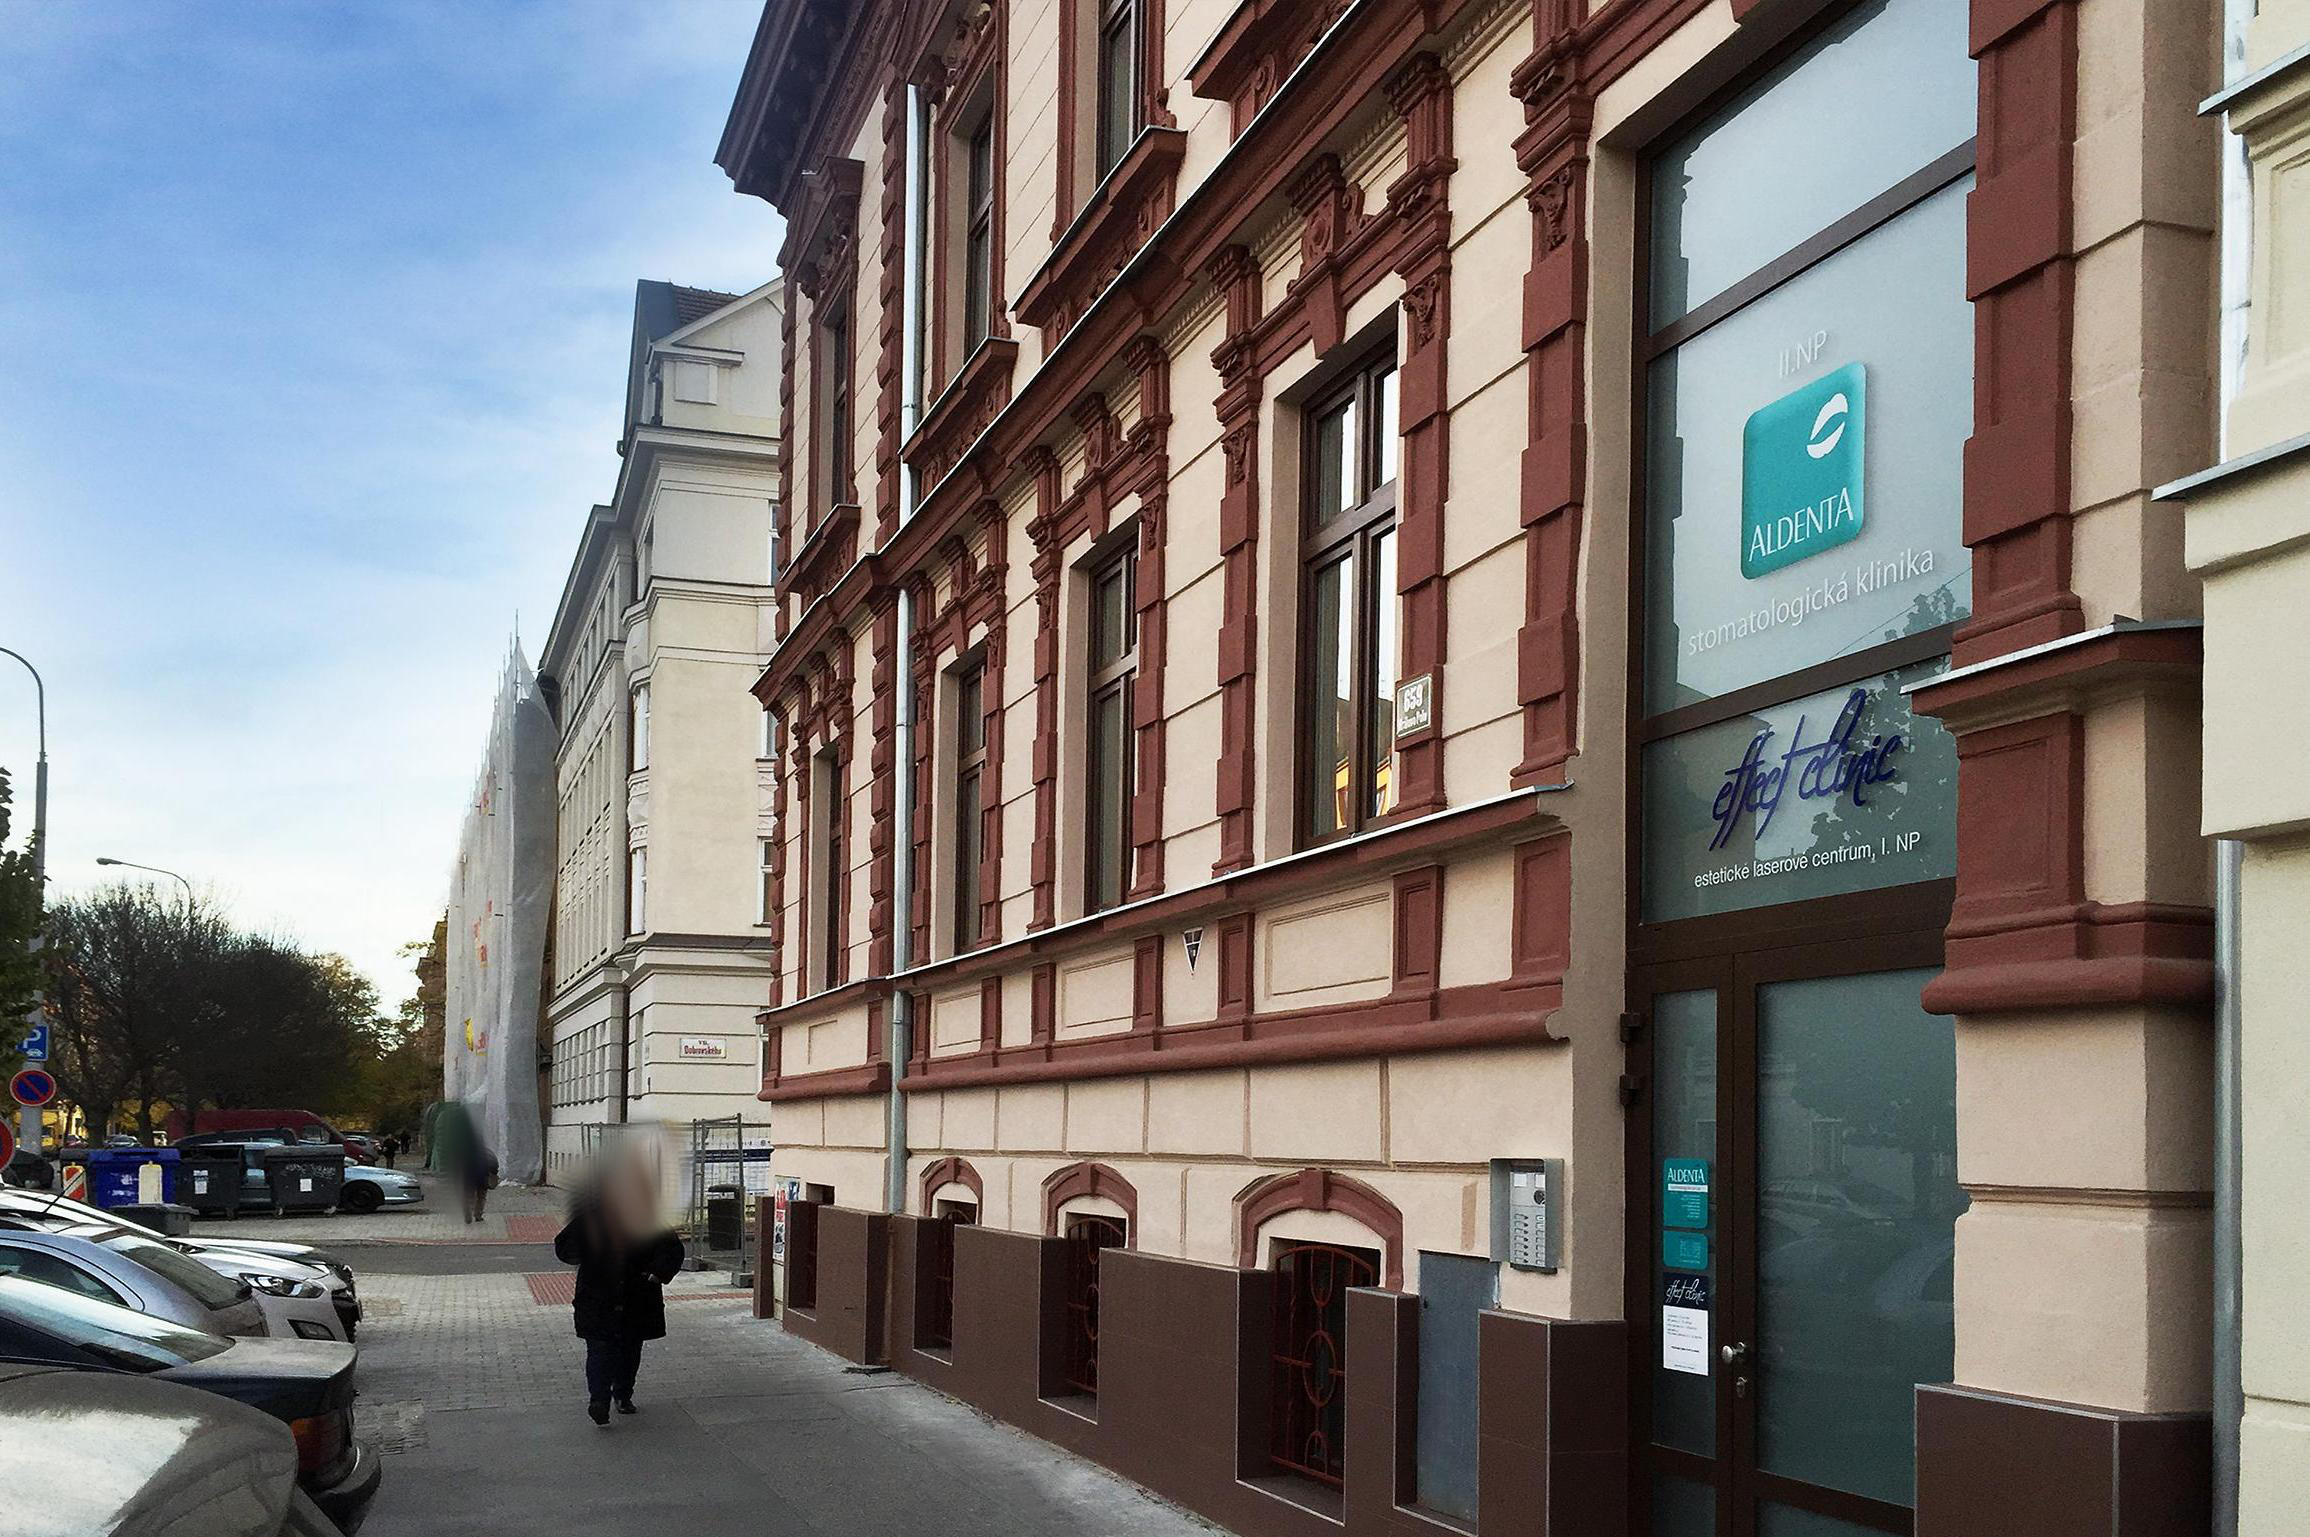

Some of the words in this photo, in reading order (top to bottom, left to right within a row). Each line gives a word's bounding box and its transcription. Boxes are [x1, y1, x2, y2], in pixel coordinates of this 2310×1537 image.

[1748, 487, 1854, 562] ALDENTA
[1688, 571, 1849, 655] stomatologická
[1856, 549, 1934, 596] klinika
[1753, 851, 1808, 877] laserové
[1812, 844, 1876, 867] centrum,
[1881, 837, 1890, 856] I.
[1896, 831, 1920, 853] NP
[1667, 1167, 1706, 1184] ALDENTA
